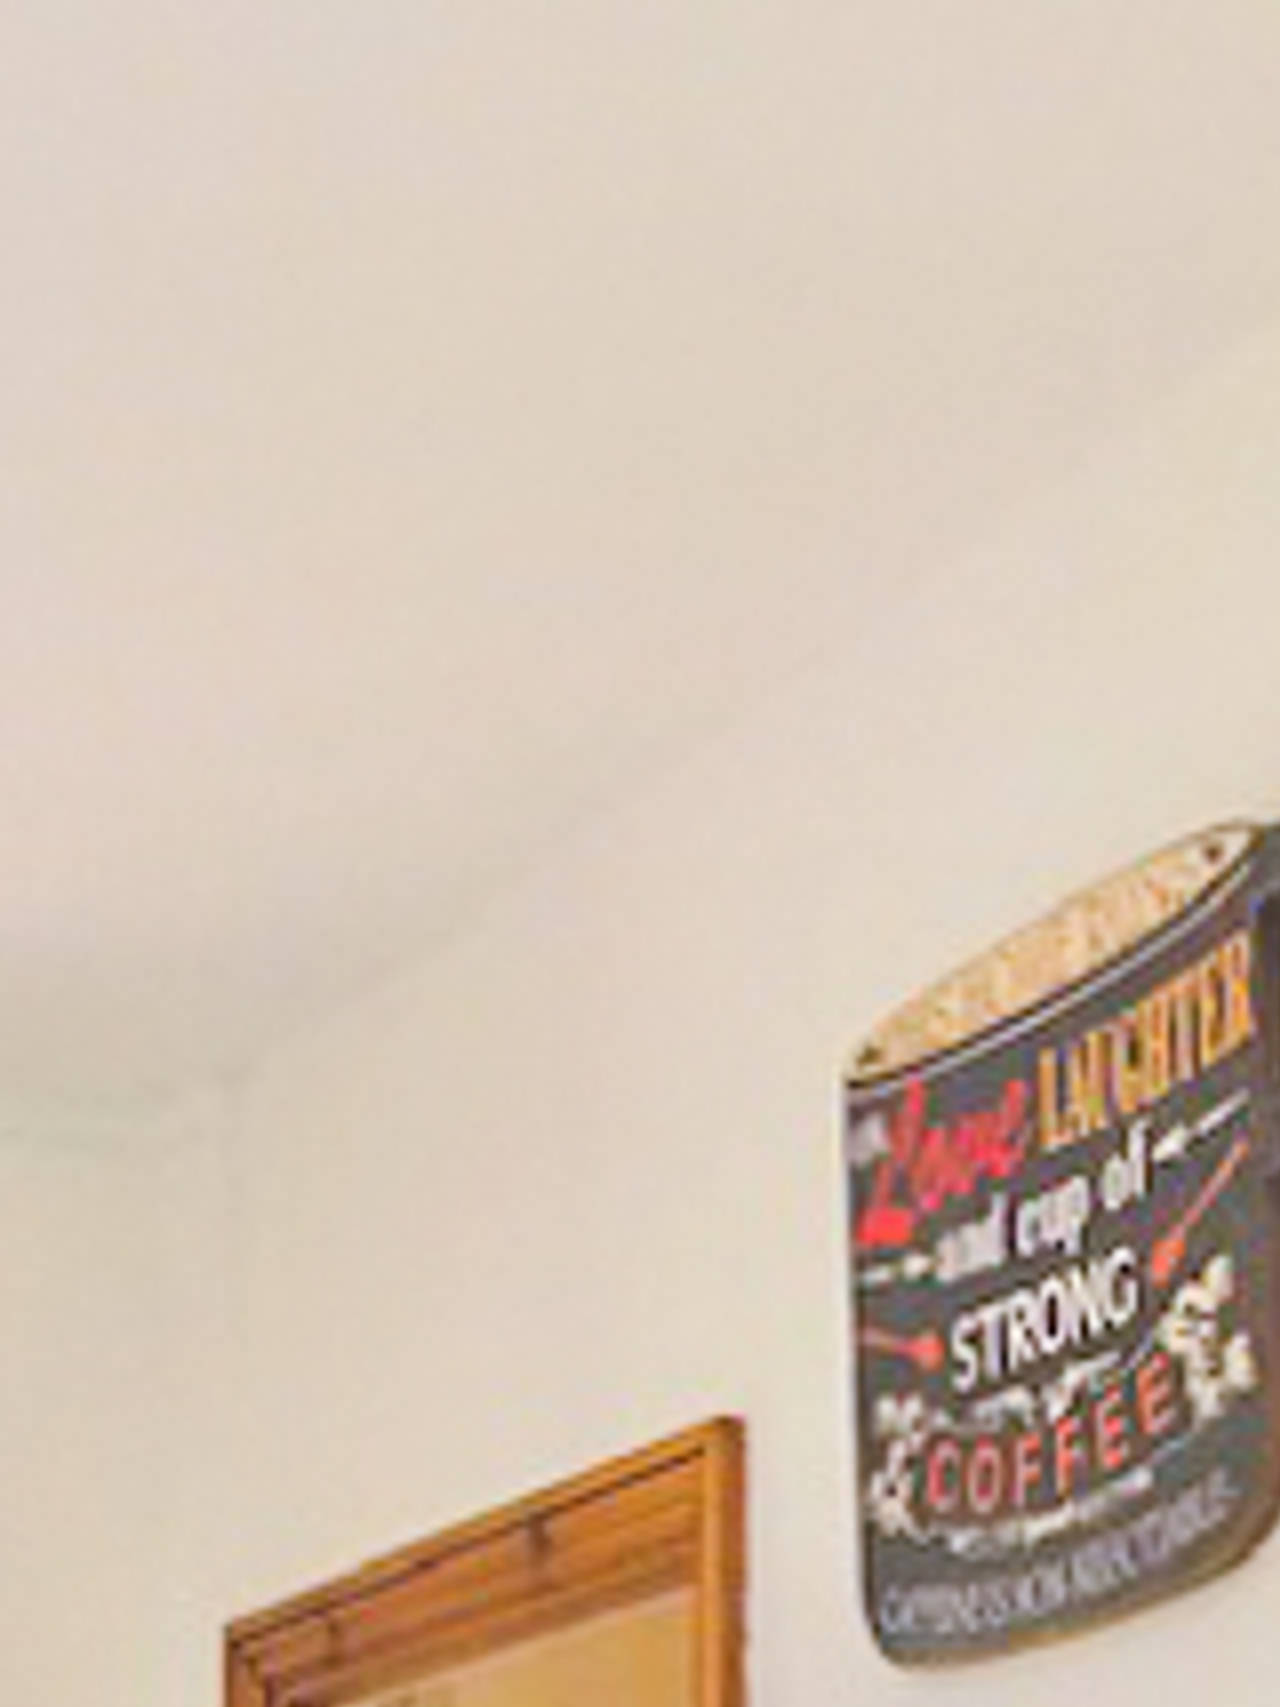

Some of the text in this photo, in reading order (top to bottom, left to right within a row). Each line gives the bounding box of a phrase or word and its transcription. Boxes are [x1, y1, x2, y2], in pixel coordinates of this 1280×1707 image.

[1036, 928, 1258, 1150] LAUGHTER
[1016, 1168, 1090, 1258] cup
[1102, 1116, 1150, 1206] of
[951, 1246, 1141, 1394] STRONG
[926, 1352, 1176, 1514] COFFEE
